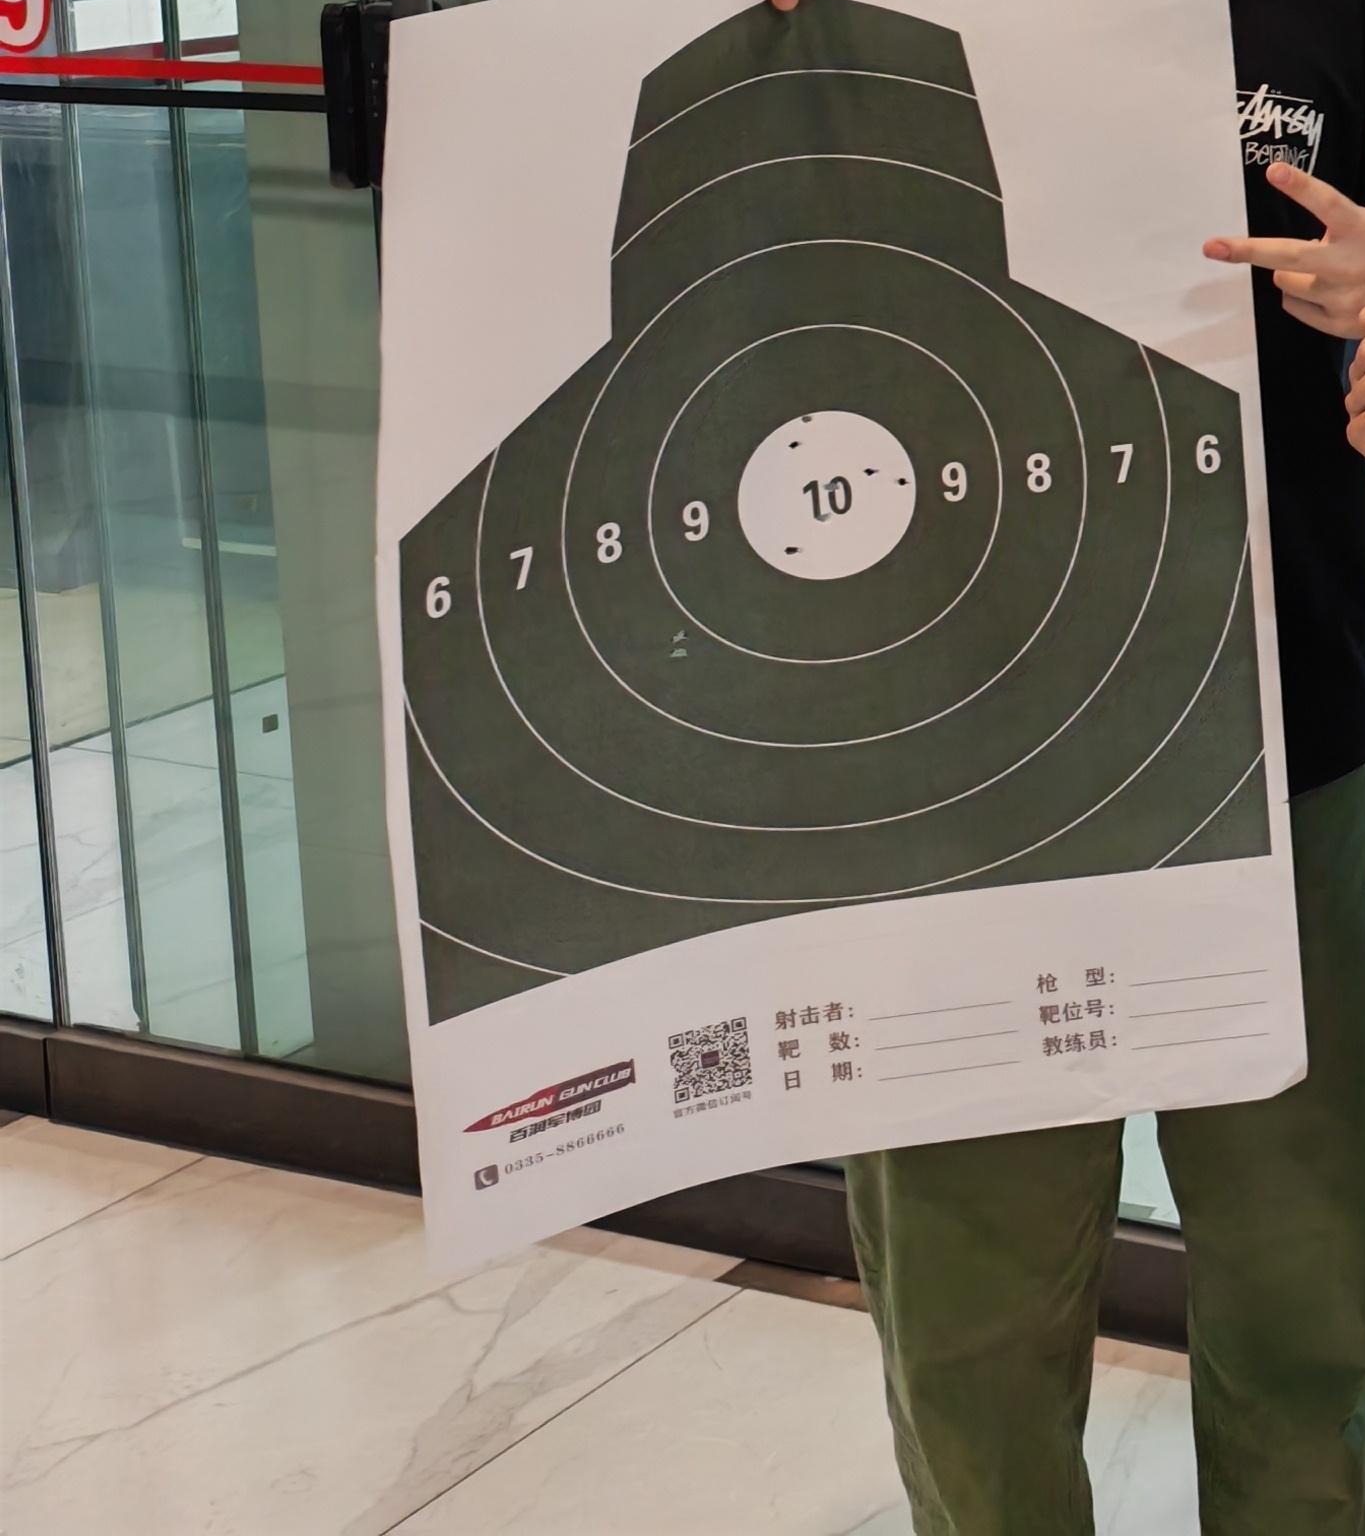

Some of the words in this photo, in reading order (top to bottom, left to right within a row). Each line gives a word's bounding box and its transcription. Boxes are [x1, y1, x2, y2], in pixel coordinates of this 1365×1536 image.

[425, 575, 453, 619] 6
[509, 546, 534, 591] 7
[596, 522, 623, 564] 8
[682, 500, 710, 542] 9
[941, 460, 968, 503] 9
[1026, 452, 1052, 493] 8
[1109, 442, 1134, 484] 7
[1195, 433, 1221, 474] 6
[775, 1001, 854, 1031] 射击者：
[1038, 998, 1115, 1026] 靶位号：
[1042, 1030, 1117, 1057] 教练员：
[490, 1093, 555, 1126] BAIRUN
[504, 1123, 625, 1175] 0335-8866666
